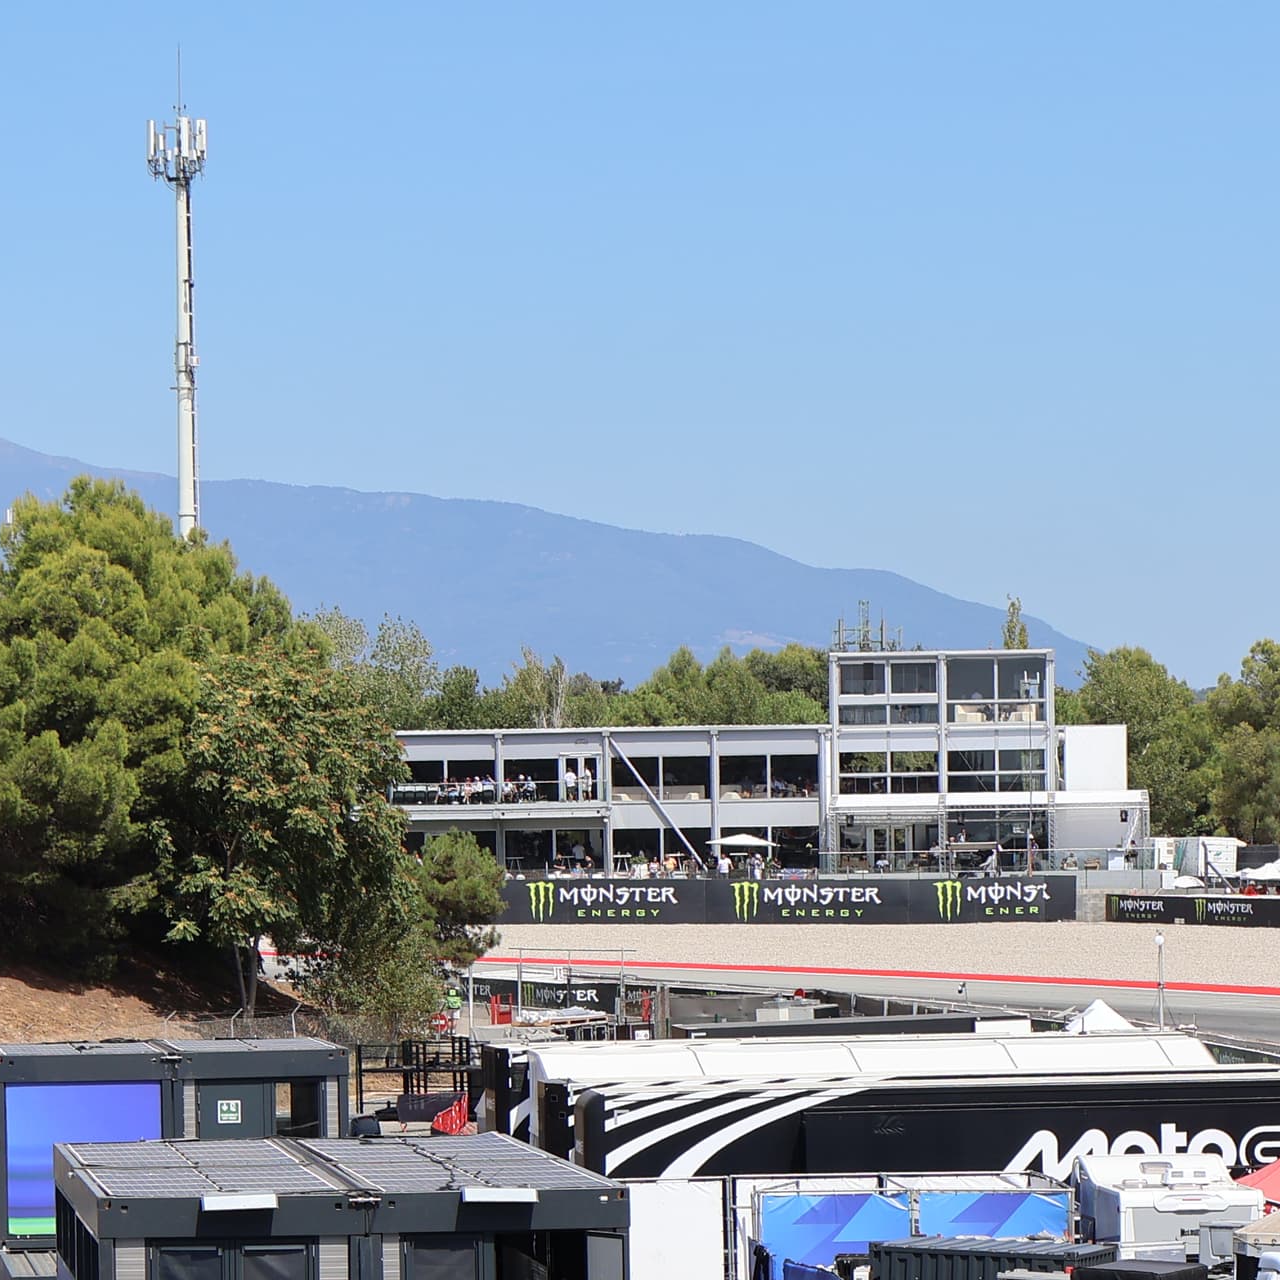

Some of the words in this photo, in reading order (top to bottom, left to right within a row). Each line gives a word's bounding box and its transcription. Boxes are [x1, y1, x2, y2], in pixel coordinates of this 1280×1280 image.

[559, 884, 678, 905] MONSTER
[764, 884, 882, 905] MONSTER
[1120, 899, 1164, 912] MONSTER
[1207, 901, 1254, 914] MONSTER
[577, 909, 660, 918] ENERGY
[781, 909, 864, 918] ENERGY
